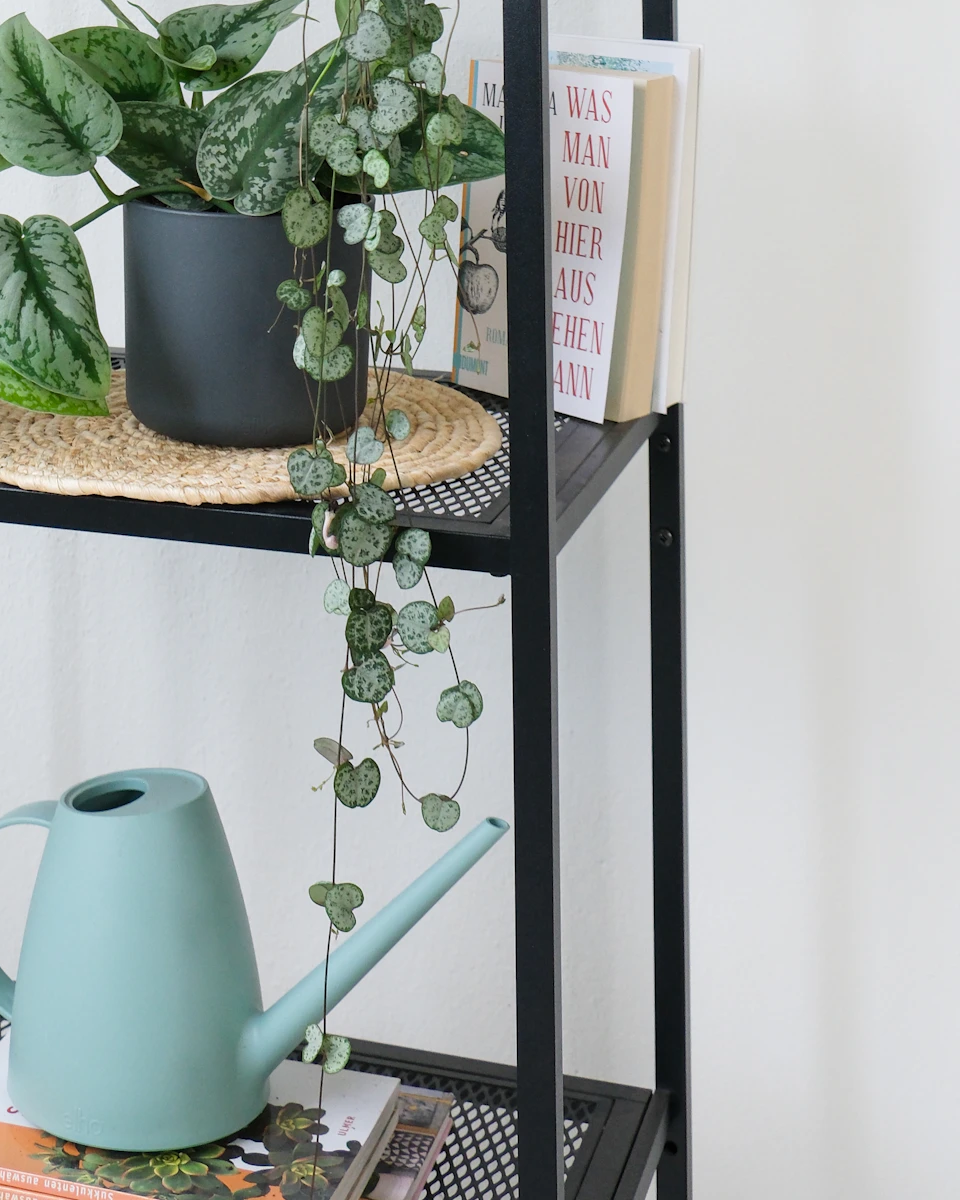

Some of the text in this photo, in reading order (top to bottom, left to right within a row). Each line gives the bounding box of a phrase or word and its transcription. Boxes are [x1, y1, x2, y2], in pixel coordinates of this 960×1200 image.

[566, 85, 613, 124] WAS
[562, 130, 611, 169] MAN
[563, 175, 605, 214] VON
[555, 220, 603, 261] HIER
[553, 267, 597, 306] AUS
[486, 326, 507, 346] ROM
[552, 311, 605, 355] EHEN
[553, 359, 594, 401] ANN
[337, 1115, 356, 1137] ULMER
[43, 1178, 115, 1200] Sukkulenten
